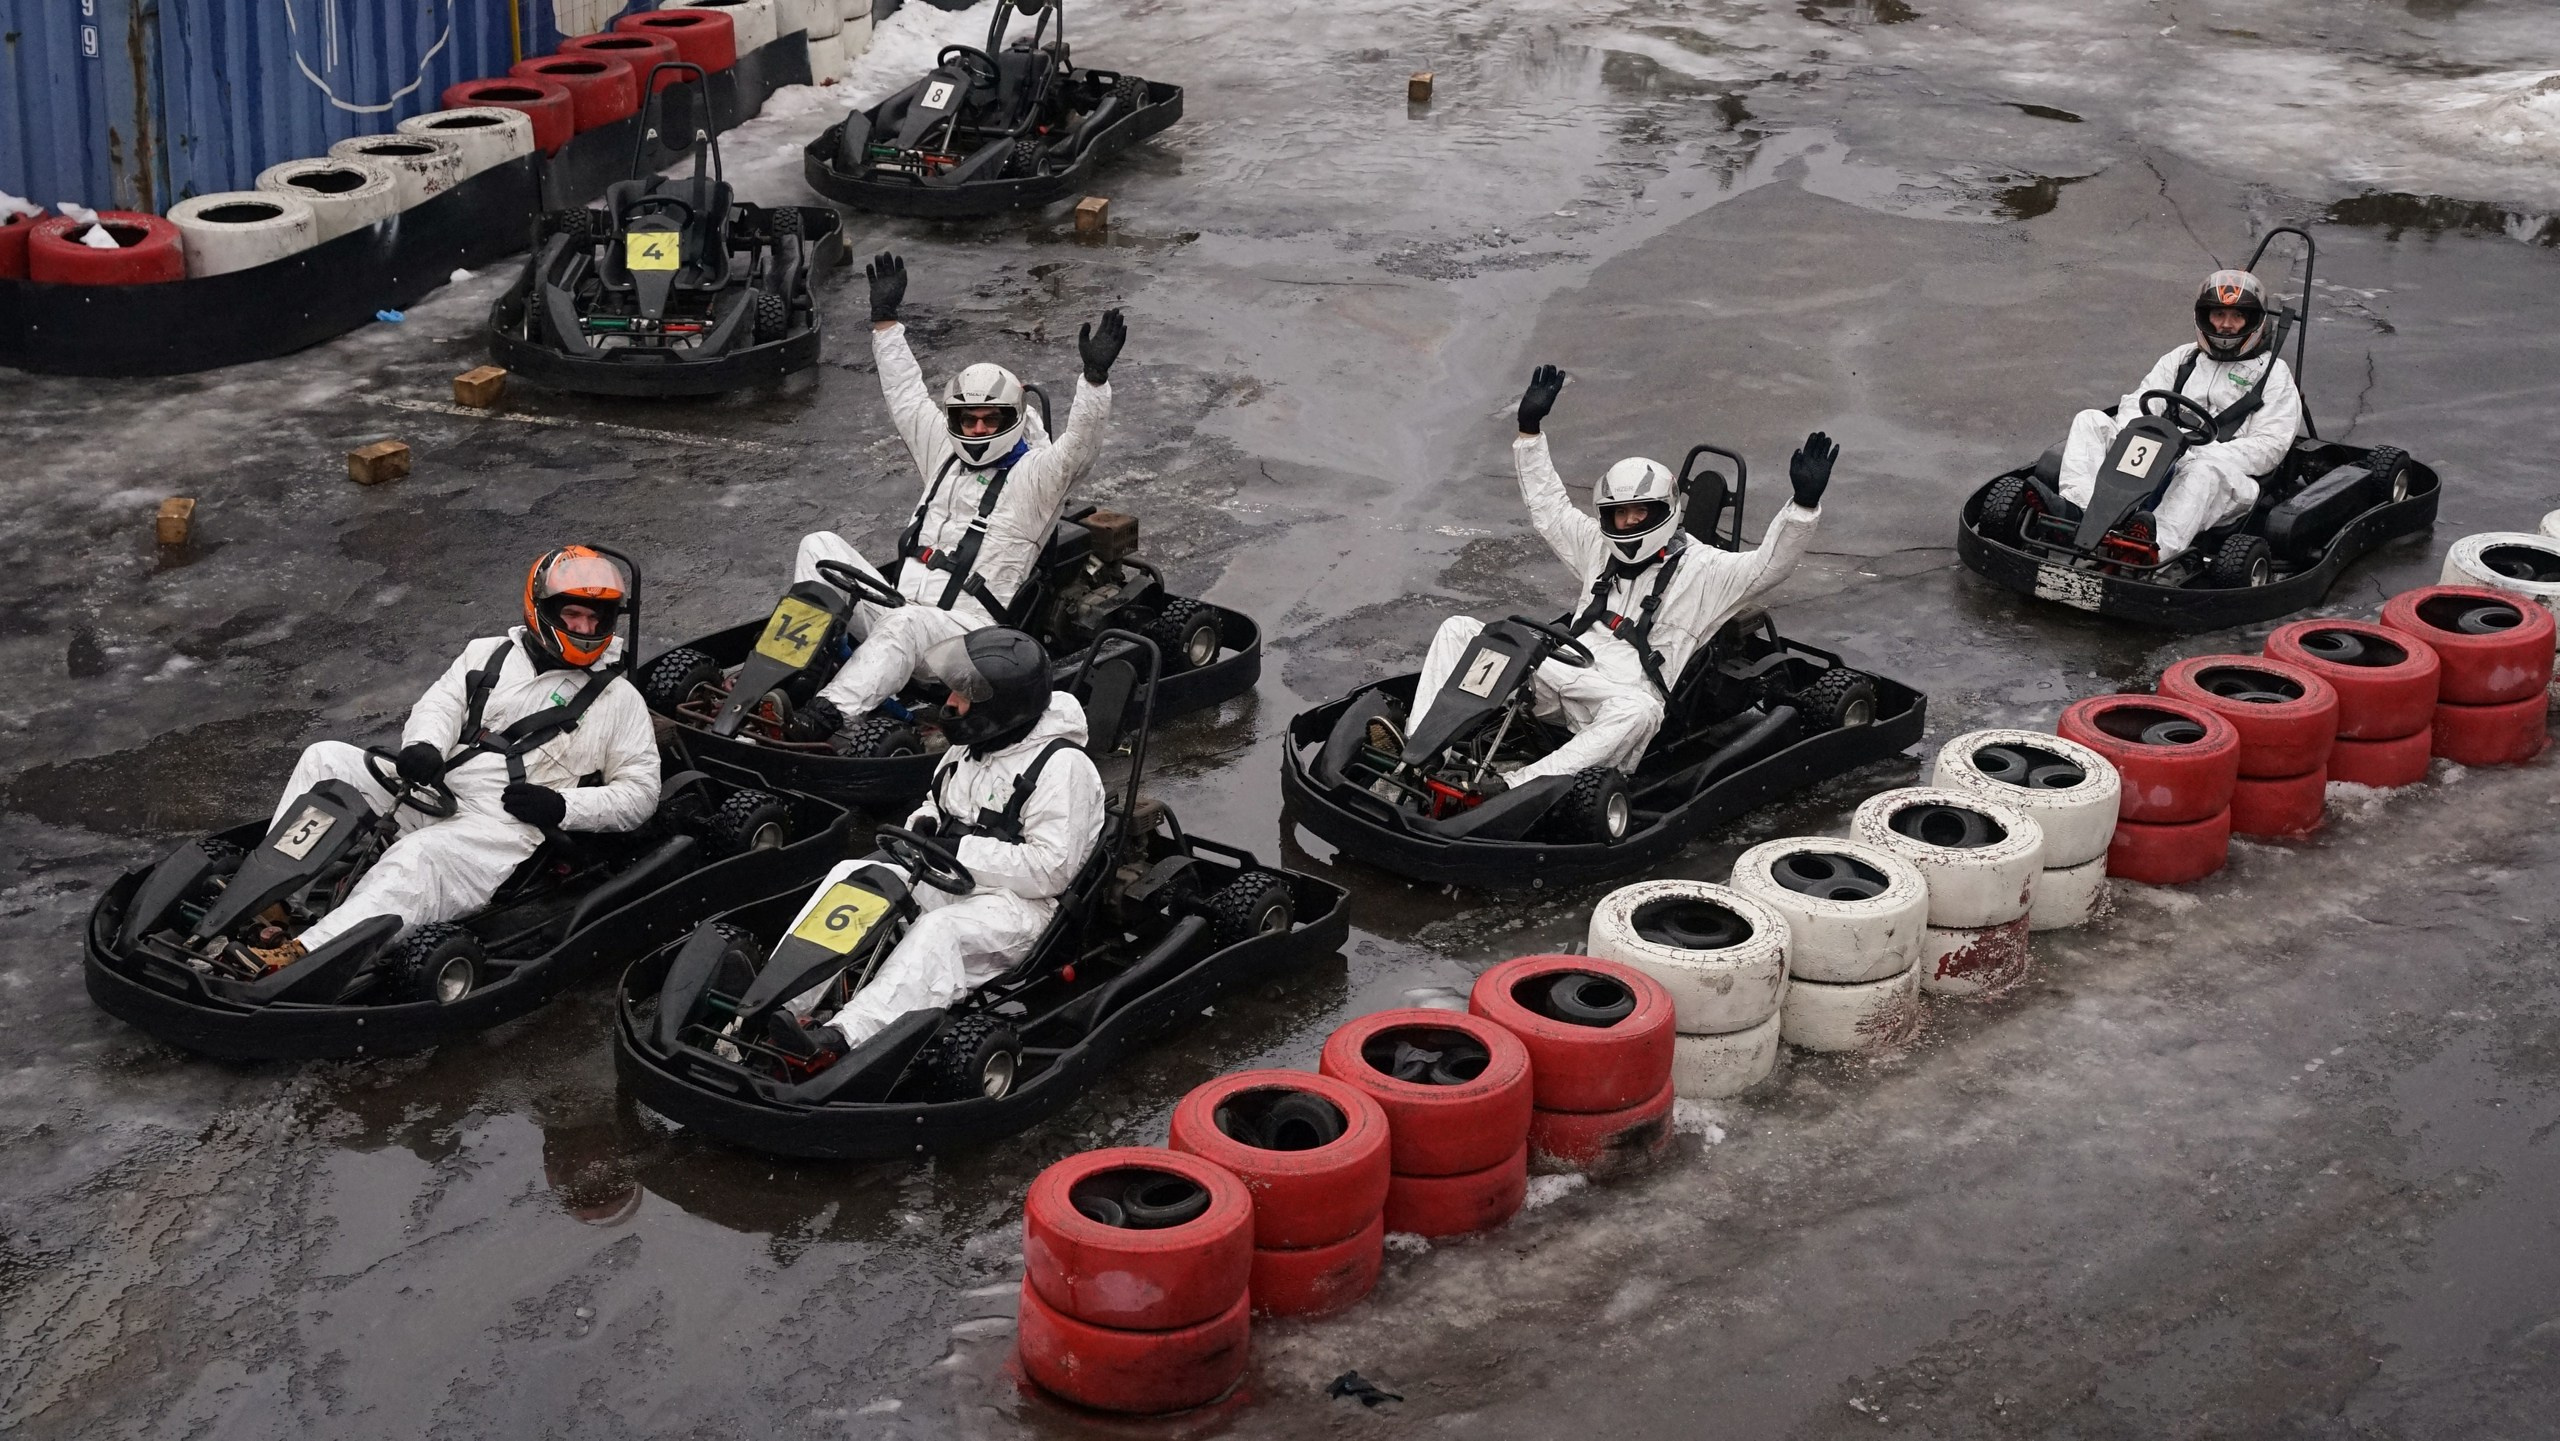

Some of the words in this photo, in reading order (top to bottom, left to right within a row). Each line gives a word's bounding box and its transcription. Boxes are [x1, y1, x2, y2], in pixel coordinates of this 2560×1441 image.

[83, 27, 96, 55] 9
[931, 88, 944, 103] 8
[642, 242, 664, 260] 4
[2130, 446, 2147, 467] 3
[773, 614, 812, 650] 14
[1478, 661, 1495, 685] 1
[292, 819, 319, 845] 5
[825, 904, 859, 931] 6
